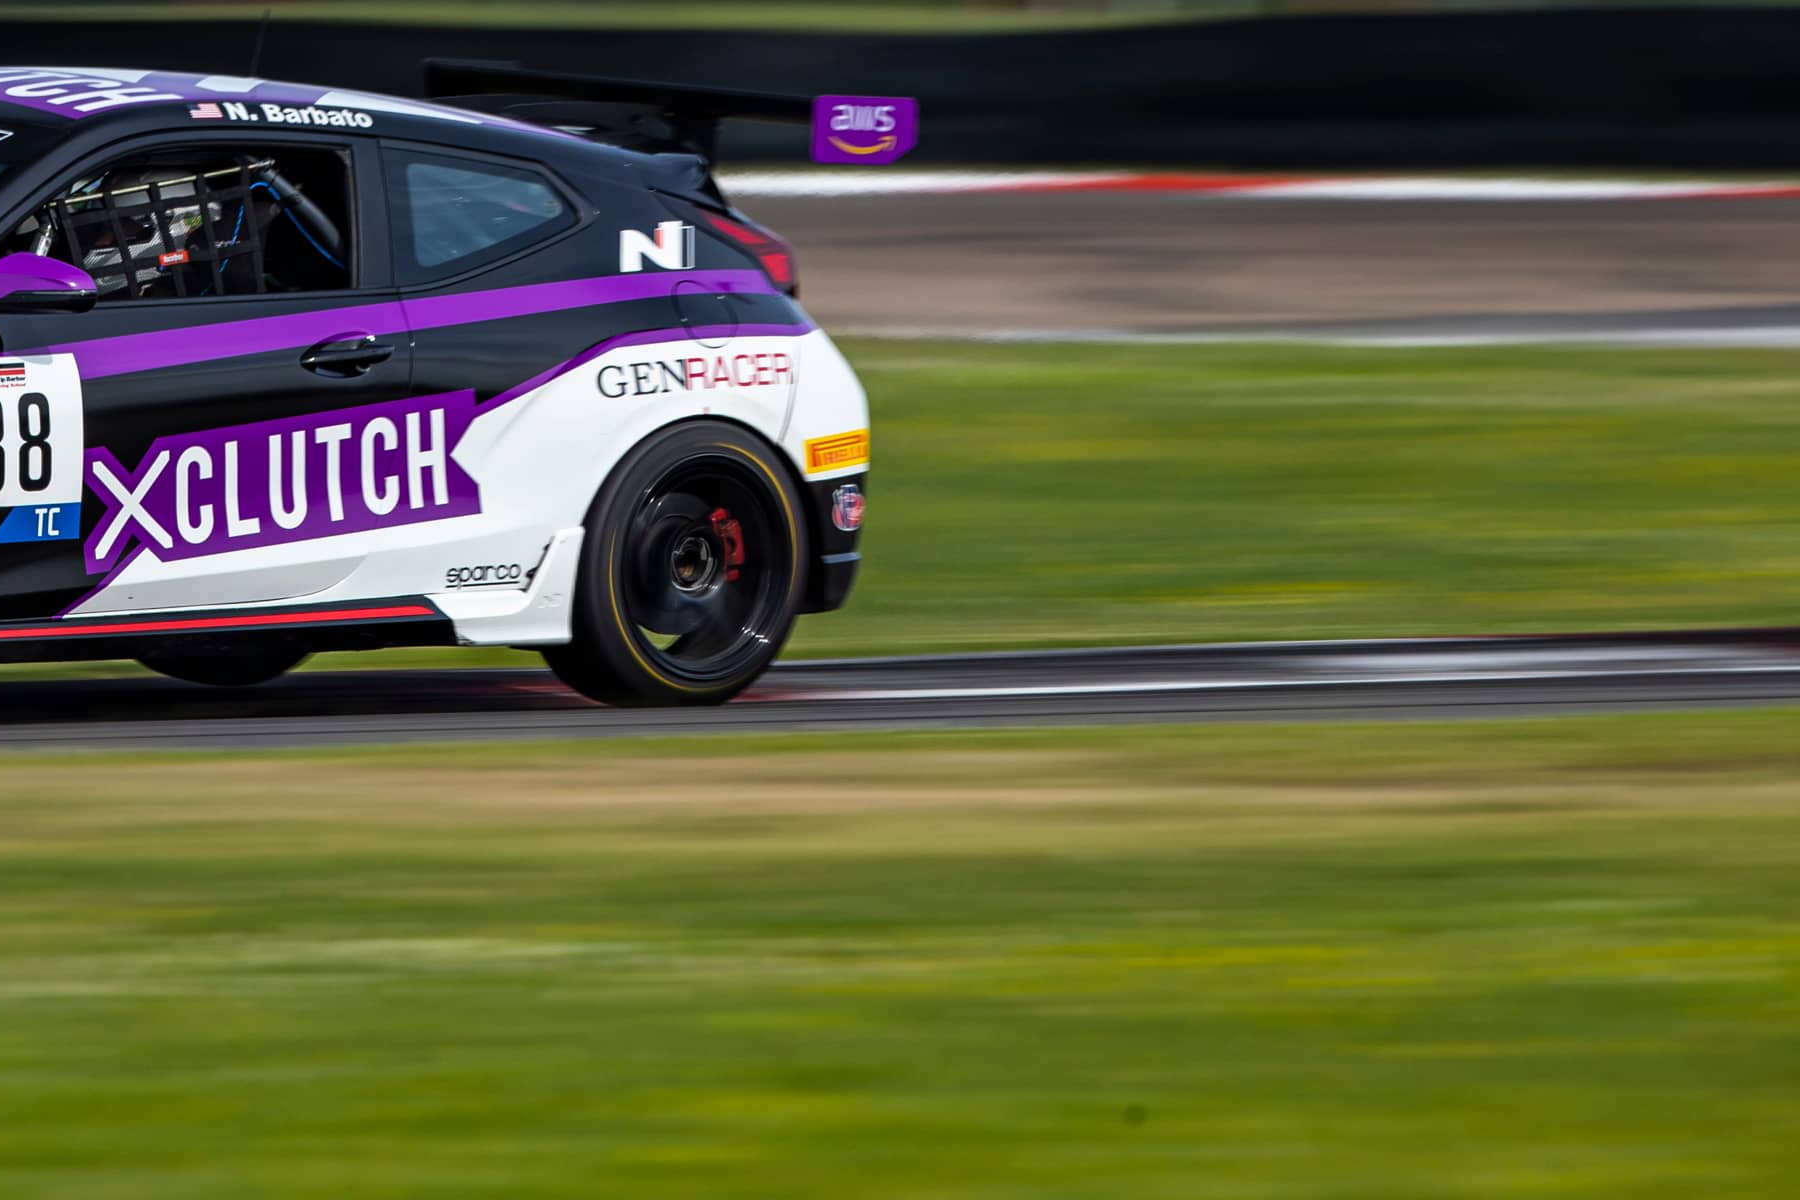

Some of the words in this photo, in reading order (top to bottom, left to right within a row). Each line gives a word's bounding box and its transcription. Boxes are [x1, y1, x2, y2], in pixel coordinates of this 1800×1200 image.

[222, 102, 258, 121] N.
[260, 103, 374, 128] Barbato
[830, 104, 897, 132] aws
[620, 220, 695, 272] N
[596, 352, 795, 398] GENRACER
[92, 408, 449, 560] XCLUTCH
[35, 507, 61, 537] TC
[446, 564, 521, 589] sparco
